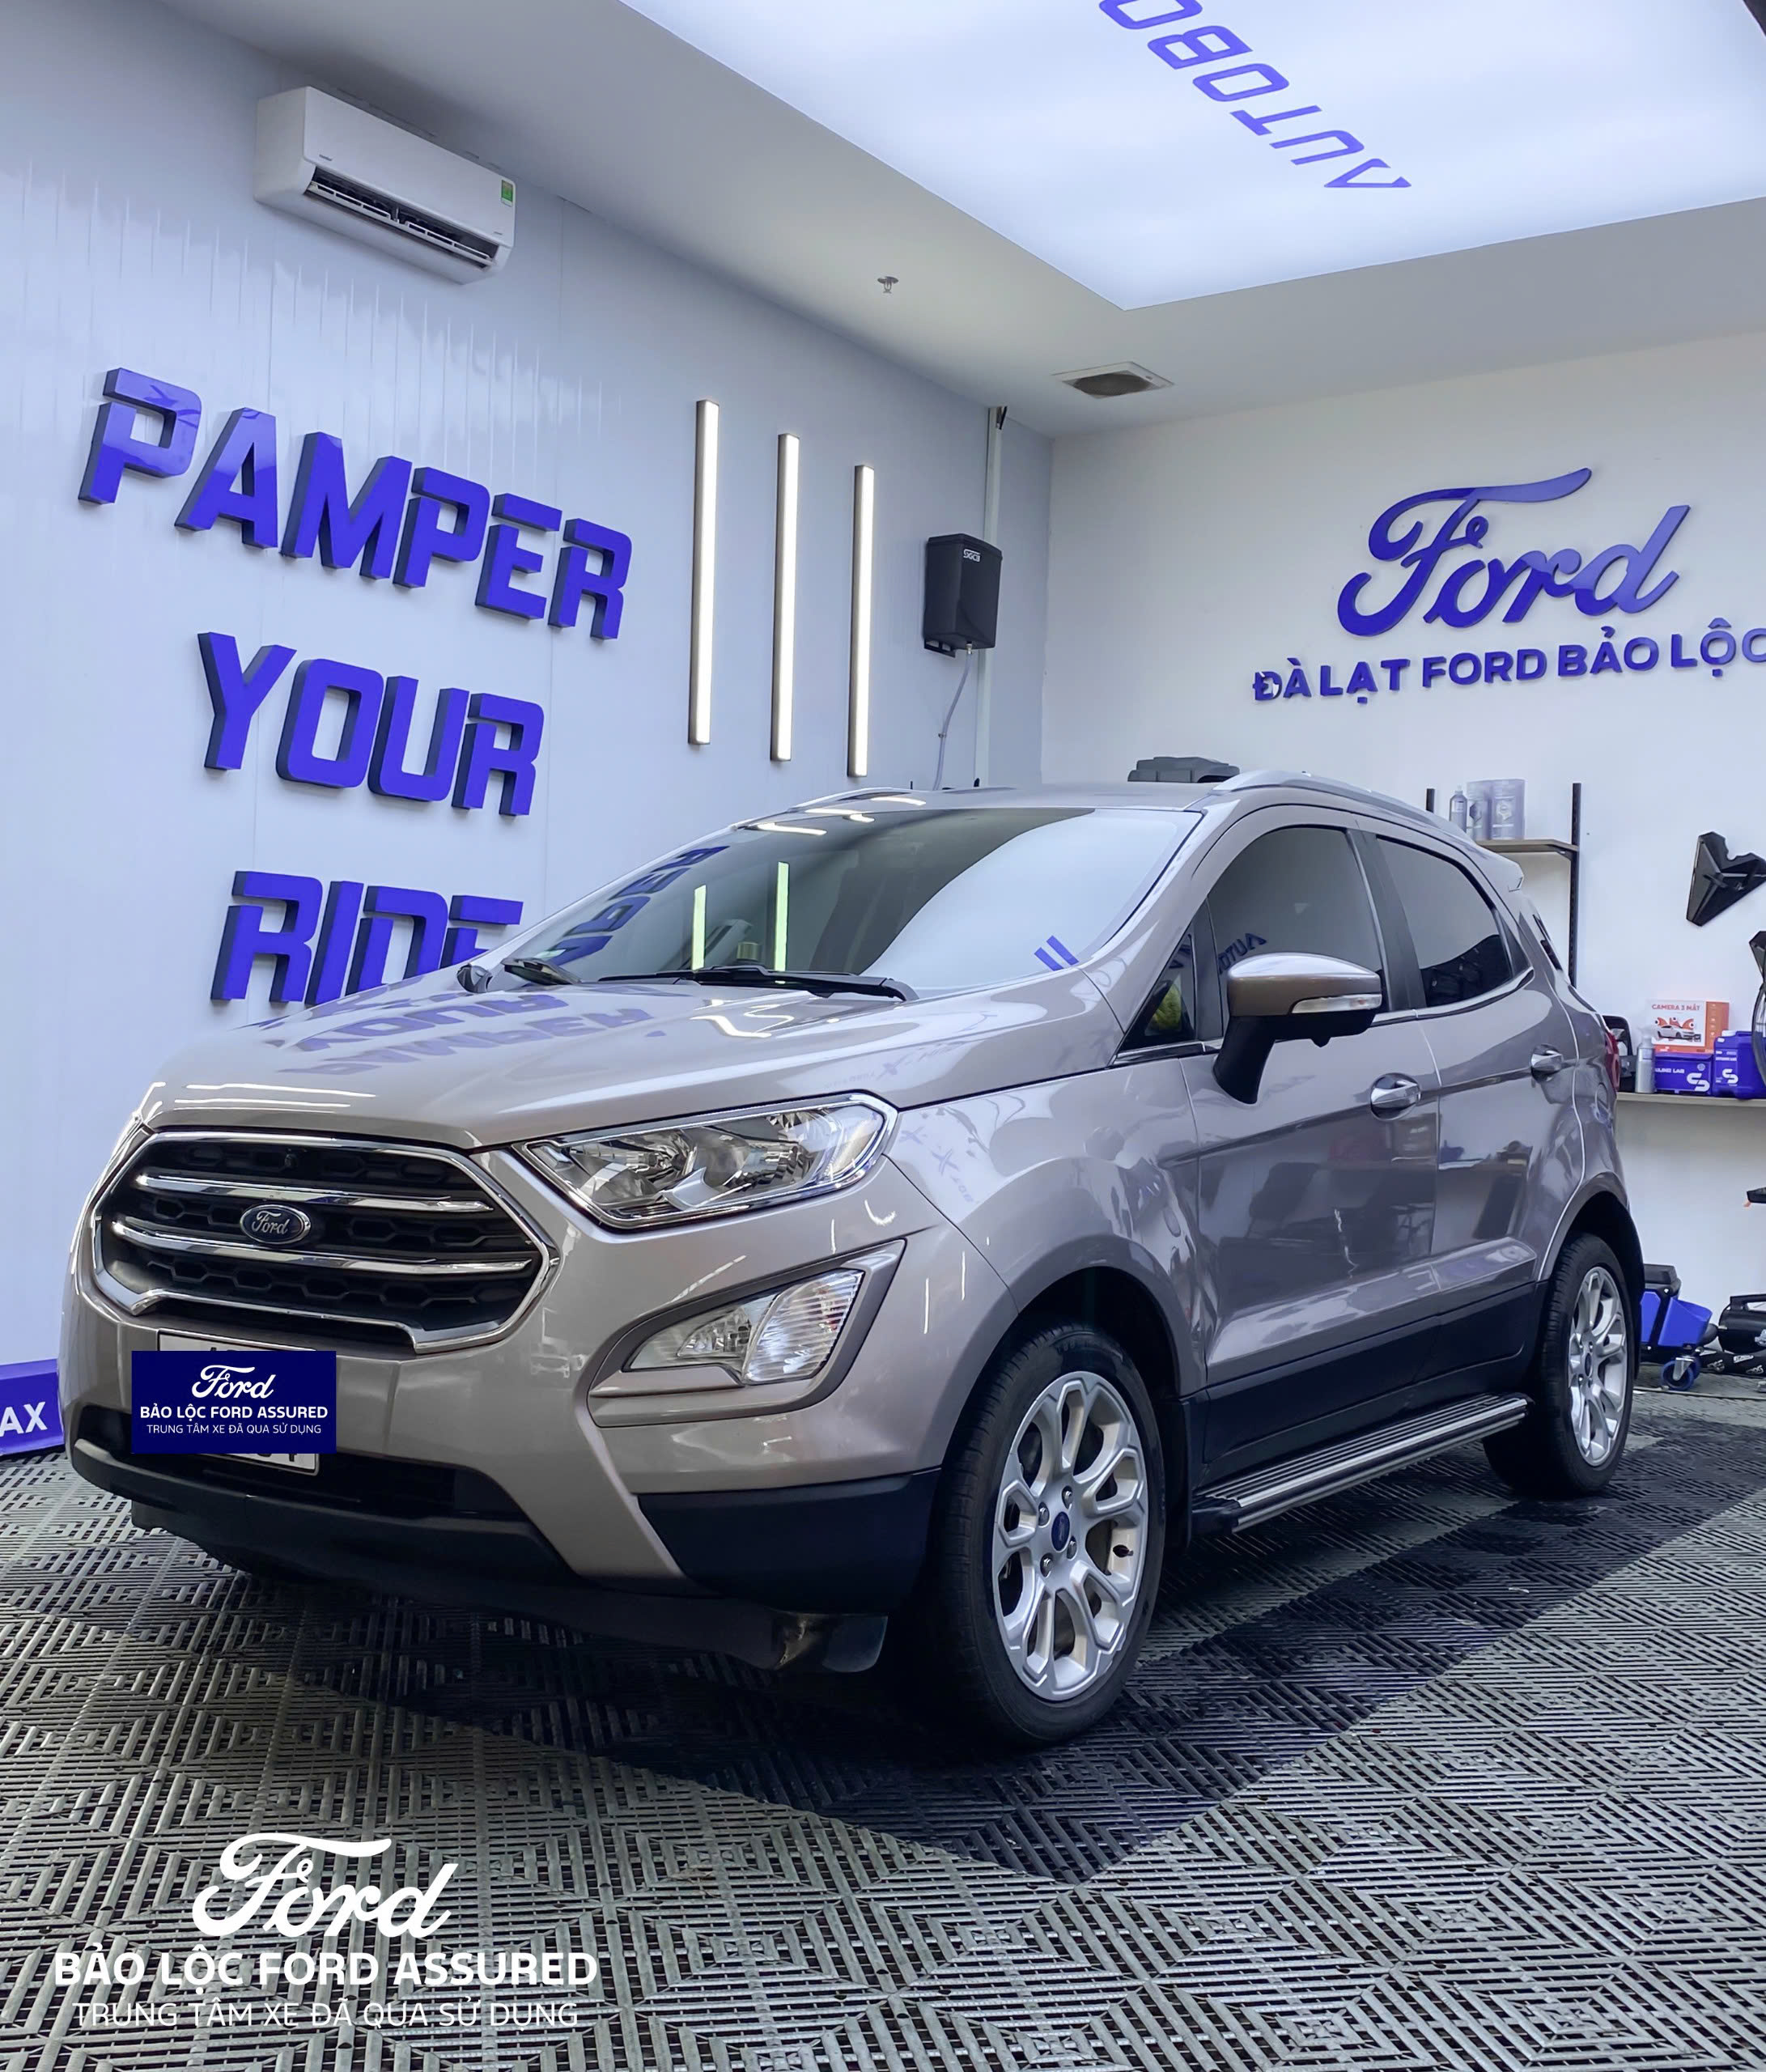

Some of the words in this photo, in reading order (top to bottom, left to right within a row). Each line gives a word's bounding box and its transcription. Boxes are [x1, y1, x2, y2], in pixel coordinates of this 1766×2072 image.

[78, 367, 633, 640] PAMPER
[1338, 468, 1691, 636] Ford
[197, 631, 545, 816] YOUR
[1253, 658, 1312, 701] ĐÀ
[1319, 658, 1411, 703] LẠT
[1422, 648, 1547, 688] FORD
[1559, 626, 1659, 677] BẢO
[1670, 618, 1766, 677] LỘC
[252, 1210, 290, 1235] Ford
